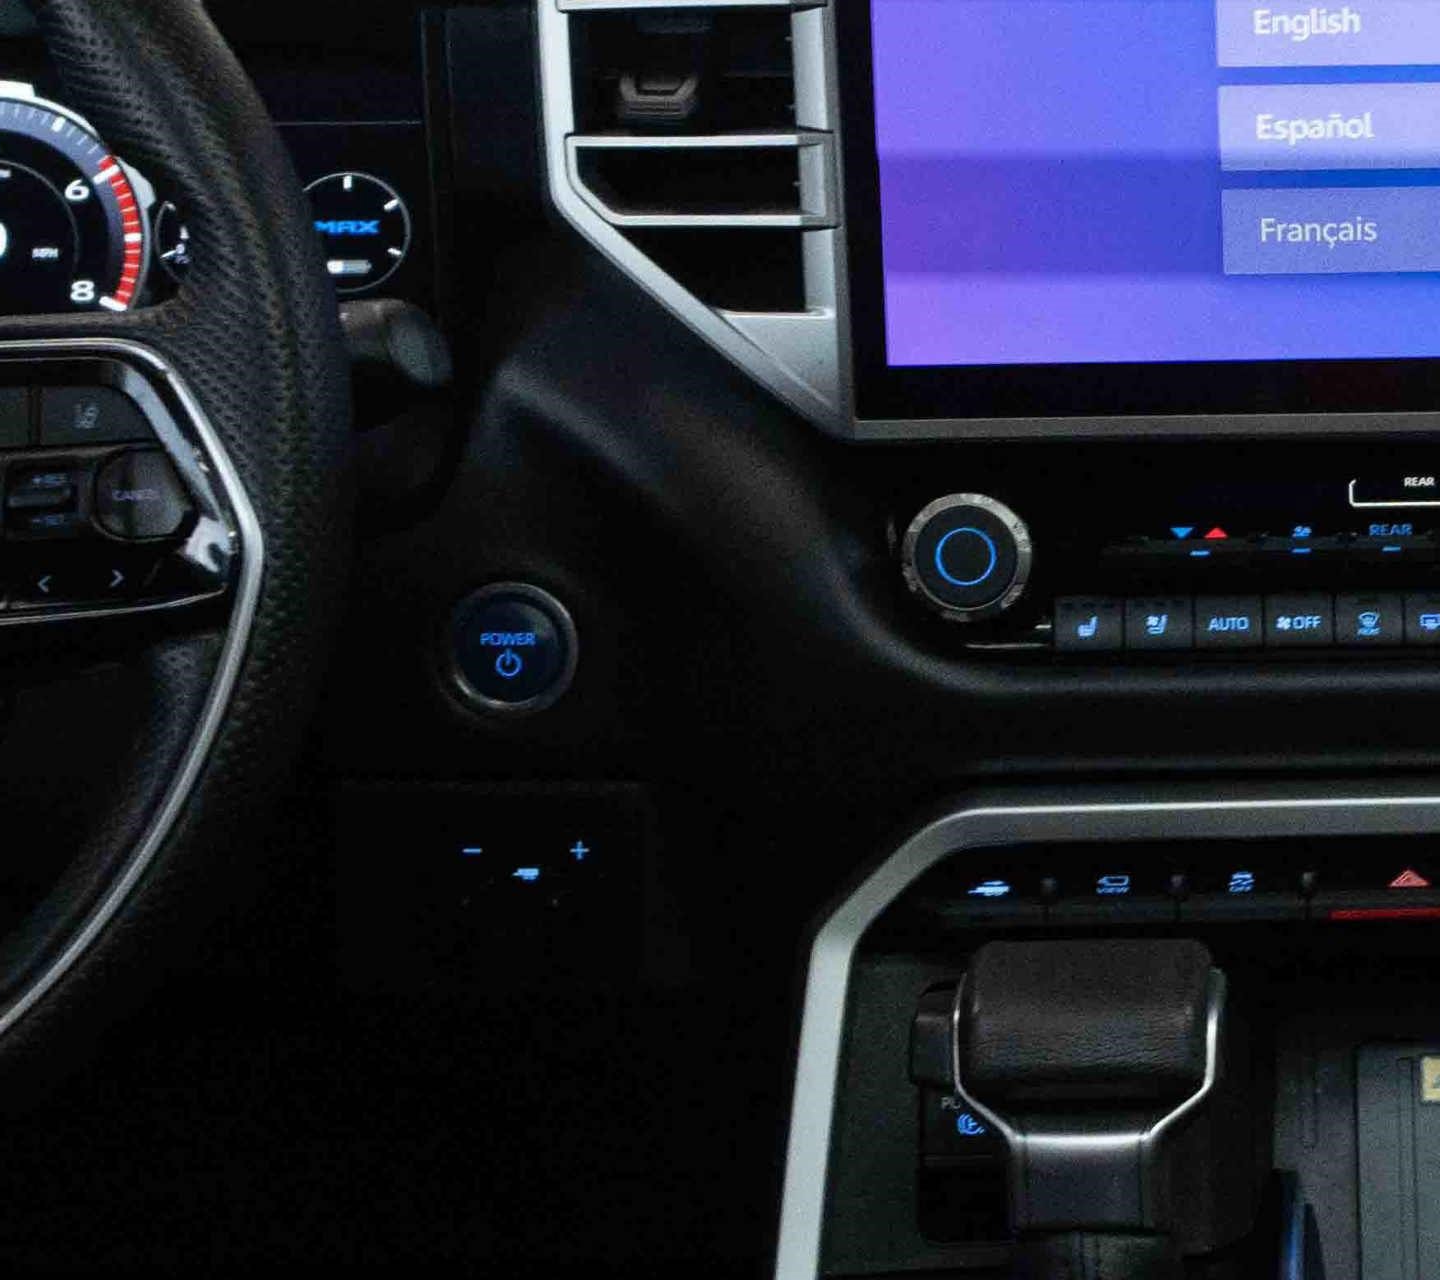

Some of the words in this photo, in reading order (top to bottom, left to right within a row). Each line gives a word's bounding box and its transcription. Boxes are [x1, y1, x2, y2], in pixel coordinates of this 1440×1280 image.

[1252, 7, 1362, 41] English
[1255, 111, 1374, 145] Español
[64, 178, 92, 203] 6
[1260, 215, 1378, 249] Français
[68, 279, 96, 303] 8
[1403, 476, 1436, 488] REAR
[1368, 522, 1414, 537] REAR
[1207, 616, 1251, 631] AUTO
[1292, 615, 1322, 631] OFF
[481, 633, 536, 645] POWER
